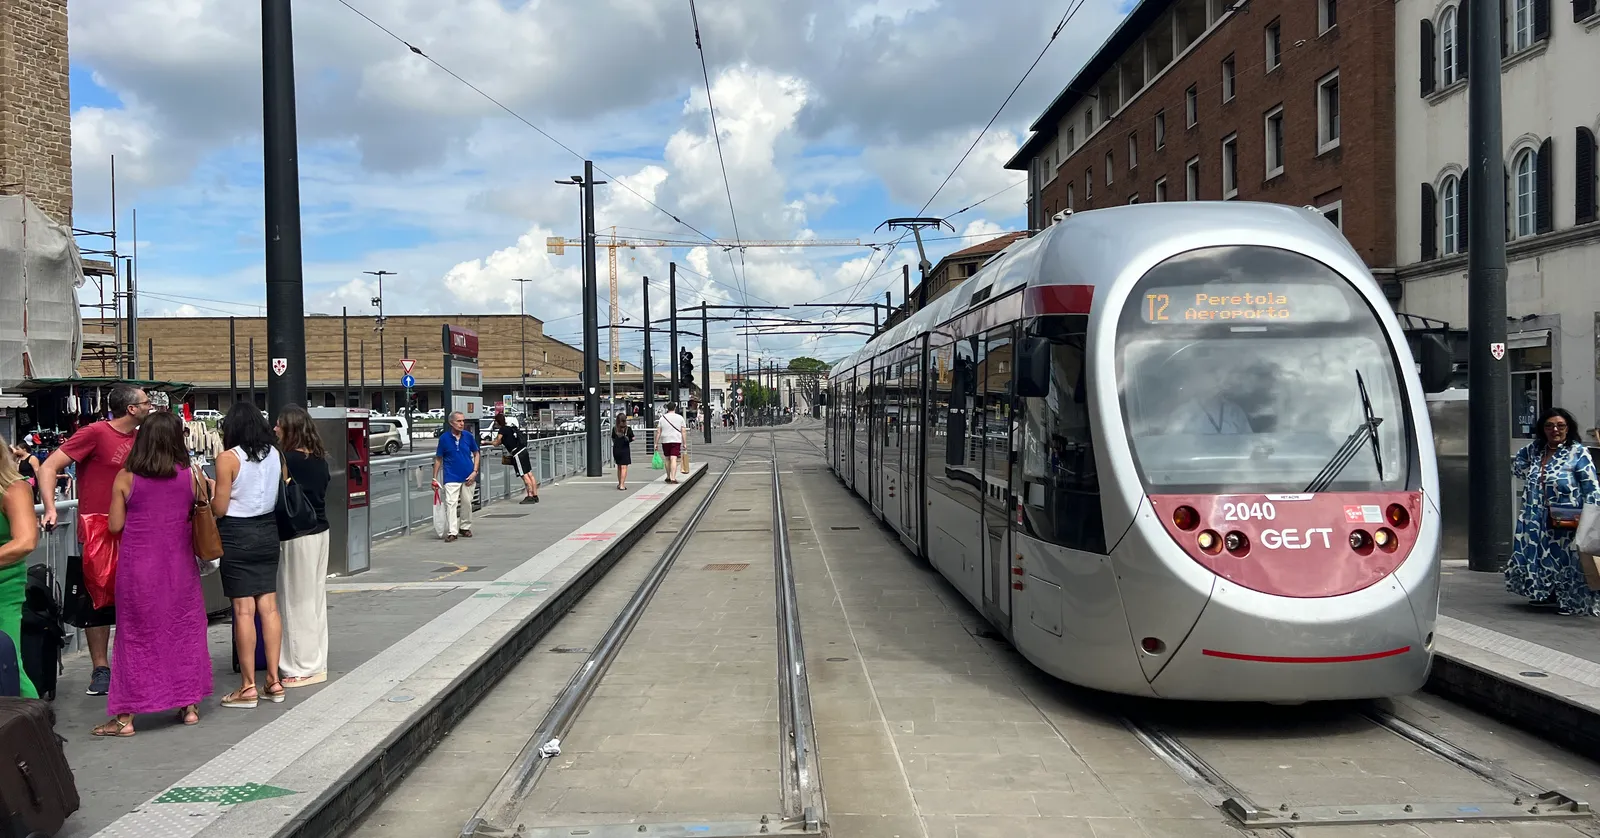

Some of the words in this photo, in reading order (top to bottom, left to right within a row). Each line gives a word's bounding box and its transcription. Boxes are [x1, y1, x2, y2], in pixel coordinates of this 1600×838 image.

[1146, 294, 1169, 321] T2
[1195, 292, 1288, 306] Peretola
[1185, 306, 1290, 320] Aeroporto
[1223, 502, 1276, 521] 2040
[1260, 527, 1333, 550] GEST
